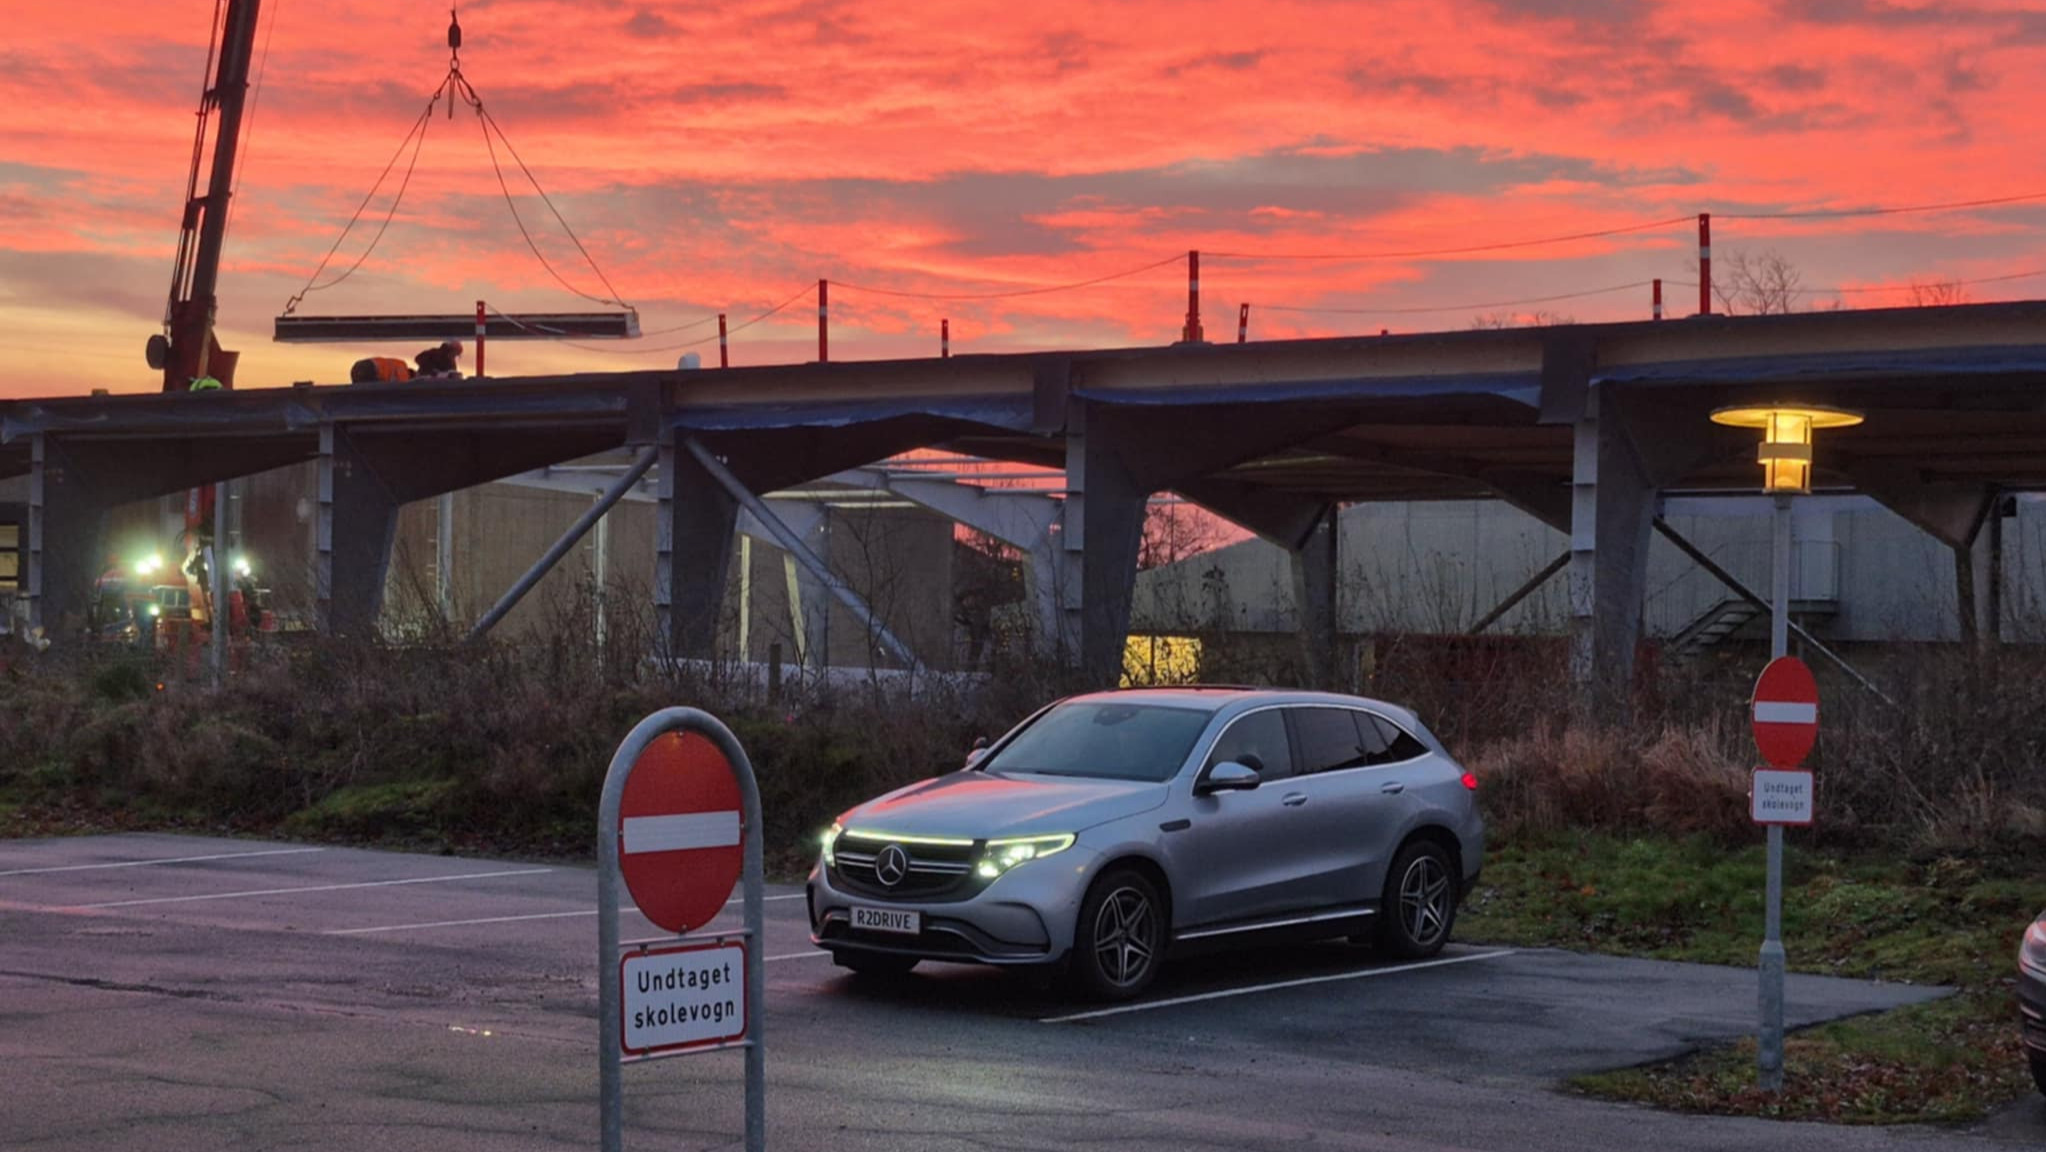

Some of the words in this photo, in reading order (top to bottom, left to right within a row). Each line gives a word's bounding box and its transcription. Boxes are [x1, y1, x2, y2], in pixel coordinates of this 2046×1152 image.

[1763, 783, 1803, 795] Undtaget
[857, 909, 912, 930] R2DRIVE
[638, 962, 730, 993] Undtaget
[634, 1000, 735, 1029] skolevogn
